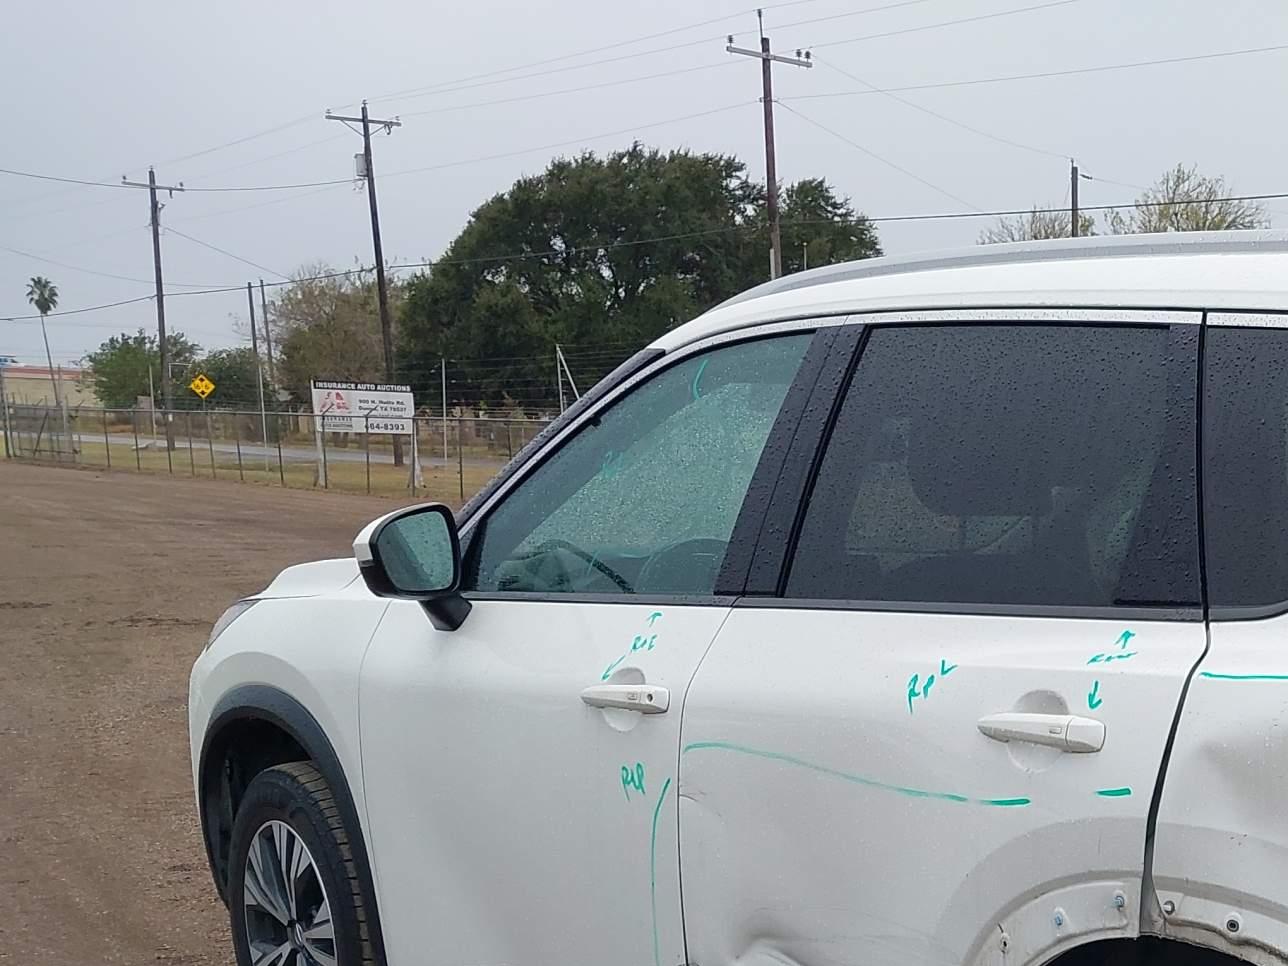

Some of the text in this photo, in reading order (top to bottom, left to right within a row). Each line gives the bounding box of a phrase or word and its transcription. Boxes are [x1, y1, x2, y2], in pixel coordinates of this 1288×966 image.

[315, 381, 410, 392] INSURANCE AUTO AUCTIONS
